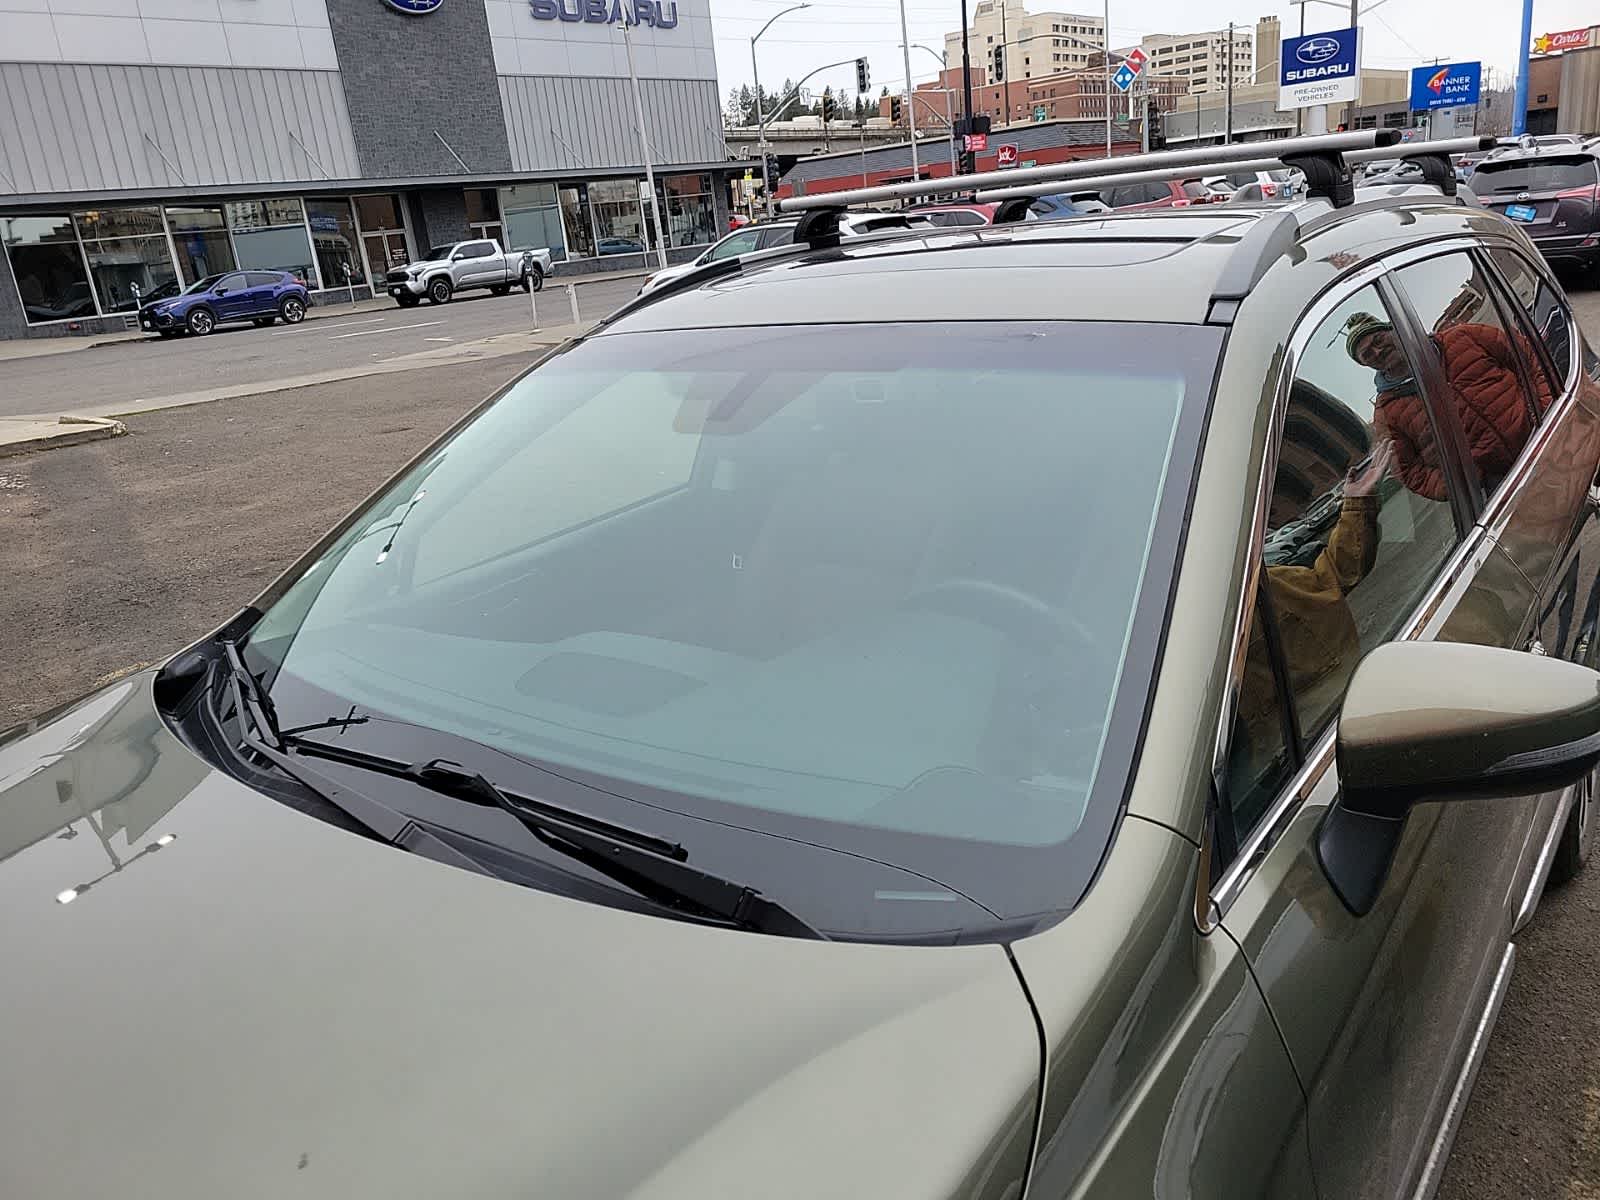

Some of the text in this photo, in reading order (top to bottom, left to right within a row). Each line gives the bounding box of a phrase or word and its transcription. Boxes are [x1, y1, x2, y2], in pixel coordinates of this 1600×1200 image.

[529, 0, 679, 29] SUBARU
[1286, 63, 1350, 81] SUBARU
[1433, 76, 1471, 87] BANNER
[1294, 84, 1339, 95] PRE-OWNED
[1445, 84, 1470, 93] BANK
[1297, 92, 1334, 102] VEHICLES
